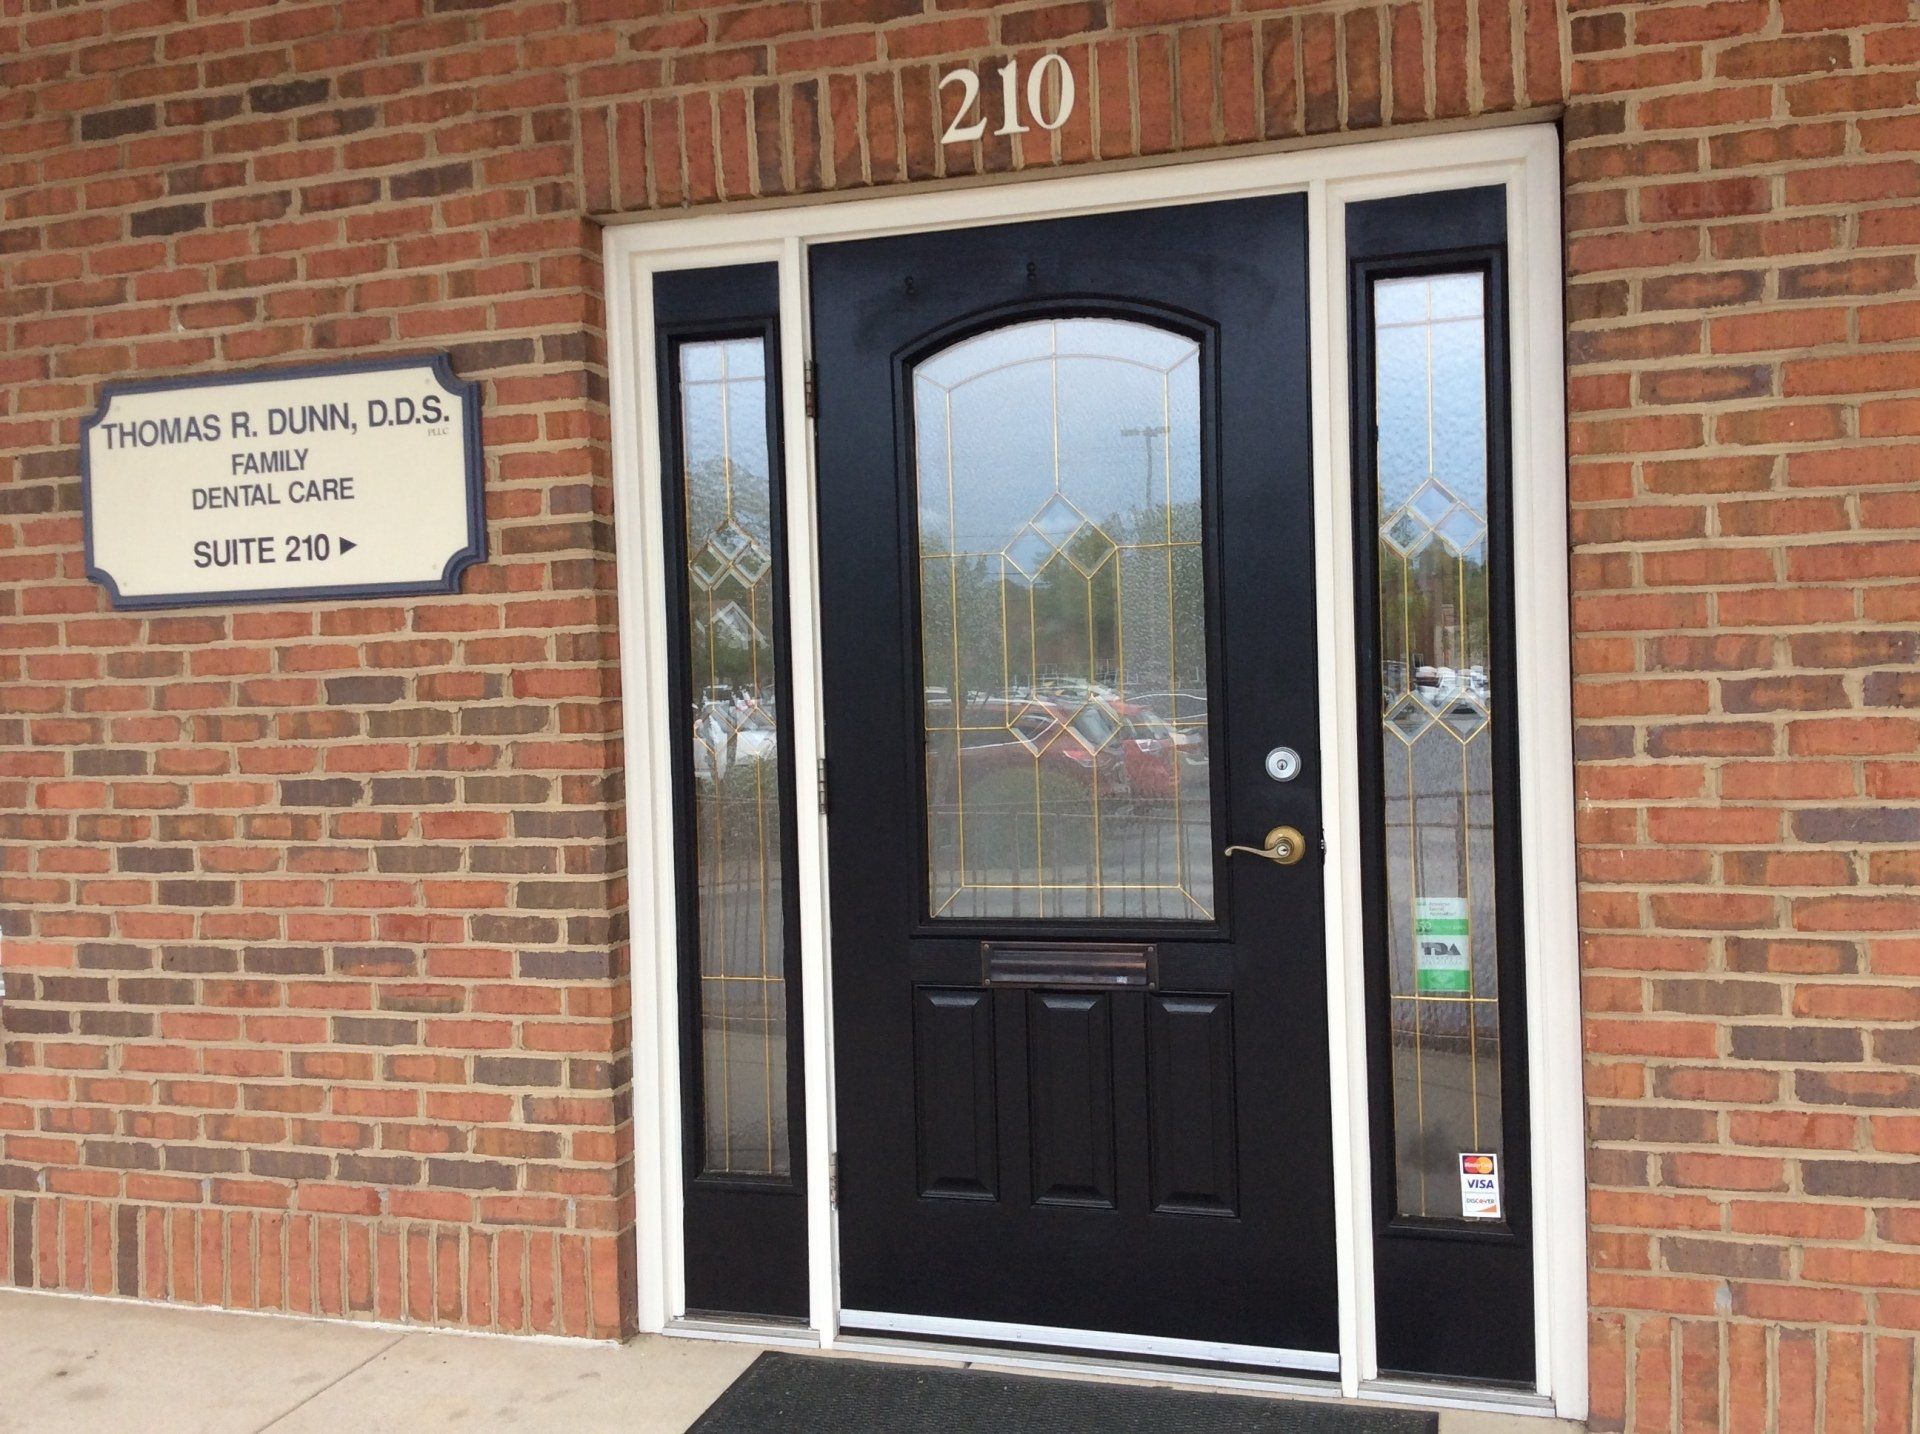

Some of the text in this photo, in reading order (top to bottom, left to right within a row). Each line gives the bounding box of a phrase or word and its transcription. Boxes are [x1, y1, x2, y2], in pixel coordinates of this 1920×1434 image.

[938, 54, 1075, 144] 210
[101, 395, 450, 449] THOMAS R. DUNN, D.D.S.
[232, 449, 309, 475] FAMILY
[192, 478, 355, 510] DENTAL CARE
[194, 534, 330, 568] SUITE 210
[1467, 1179, 1495, 1189] VISA
